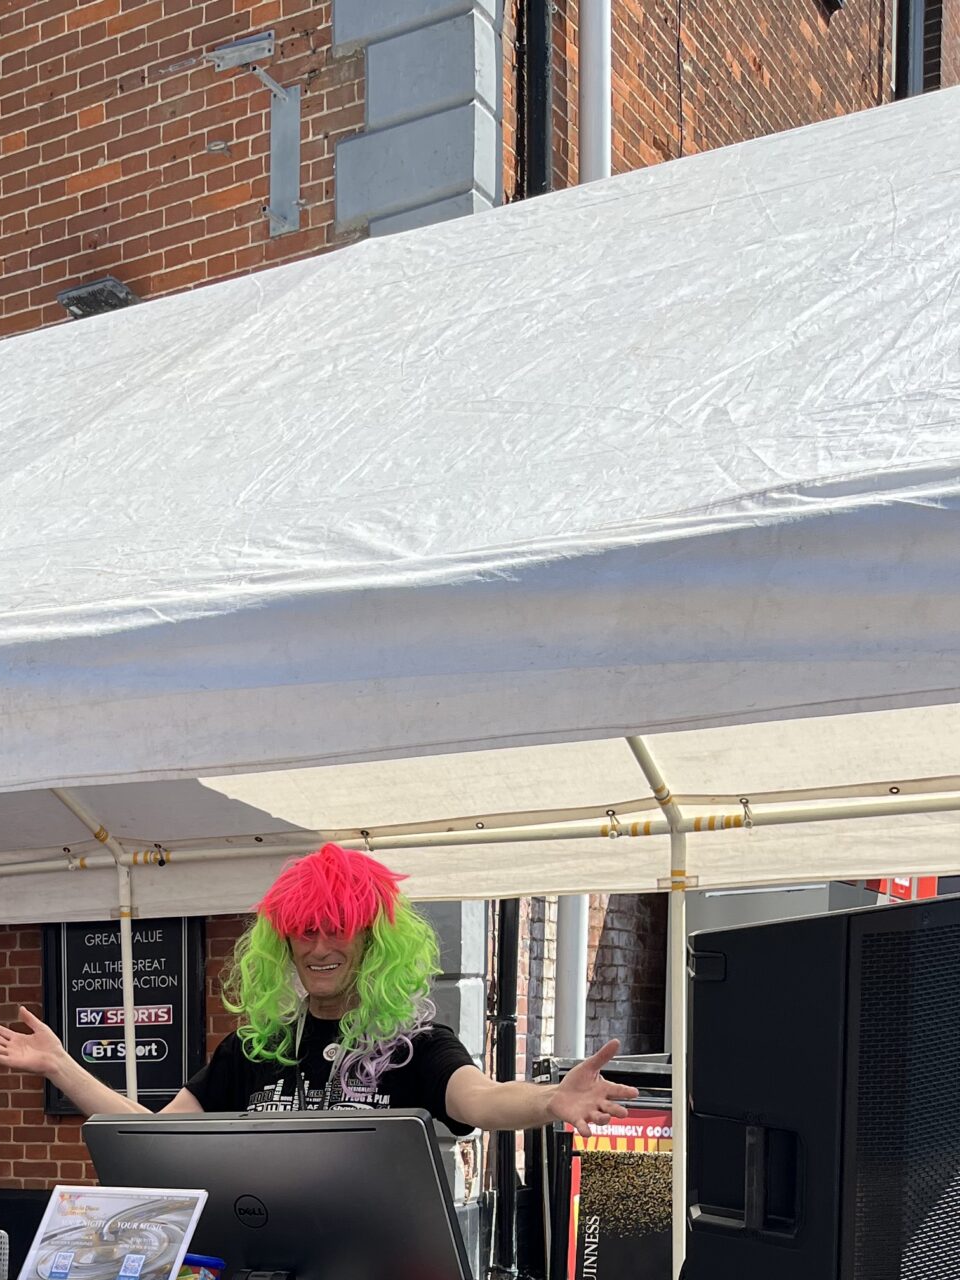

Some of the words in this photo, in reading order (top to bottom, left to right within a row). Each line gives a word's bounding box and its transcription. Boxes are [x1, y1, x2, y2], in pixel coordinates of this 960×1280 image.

[131, 930, 163, 943] ALUE
[82, 962, 102, 974] ALL
[104, 960, 123, 973] THE
[132, 974, 178, 989] ACTION
[80, 1009, 103, 1026] sky
[92, 1045, 115, 1058] BT
[116, 1042, 158, 1057] Sort
[646, 1126, 672, 1137] GOO
[237, 1207, 265, 1216] DELL
